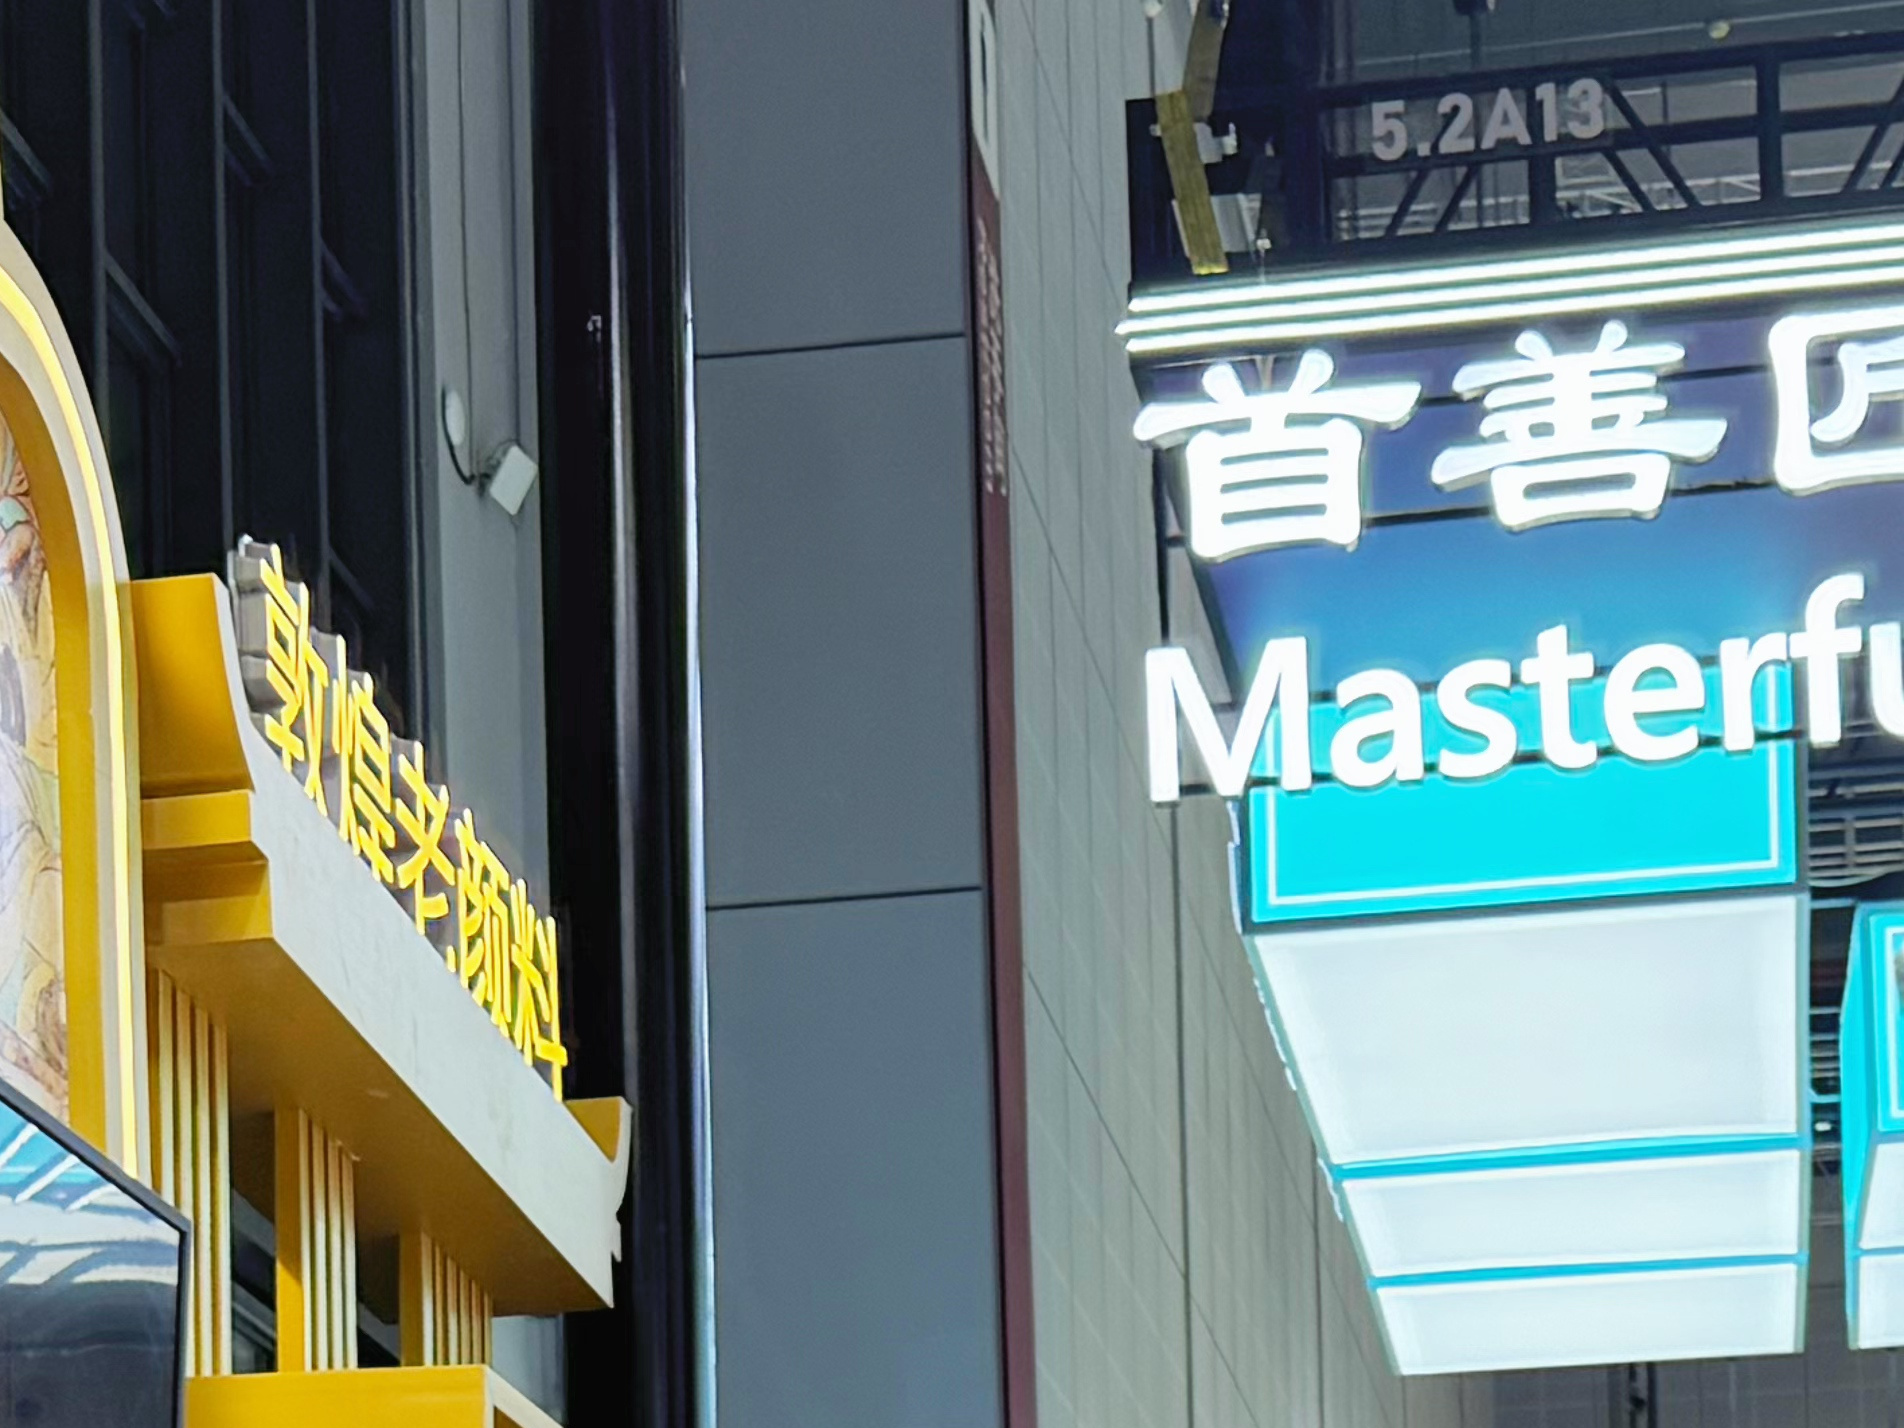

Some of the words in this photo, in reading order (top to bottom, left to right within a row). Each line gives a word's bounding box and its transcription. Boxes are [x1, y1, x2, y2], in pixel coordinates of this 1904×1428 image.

[1371, 77, 1607, 162] 5.2A13
[259, 541, 568, 1102] 敦煌老颜料
